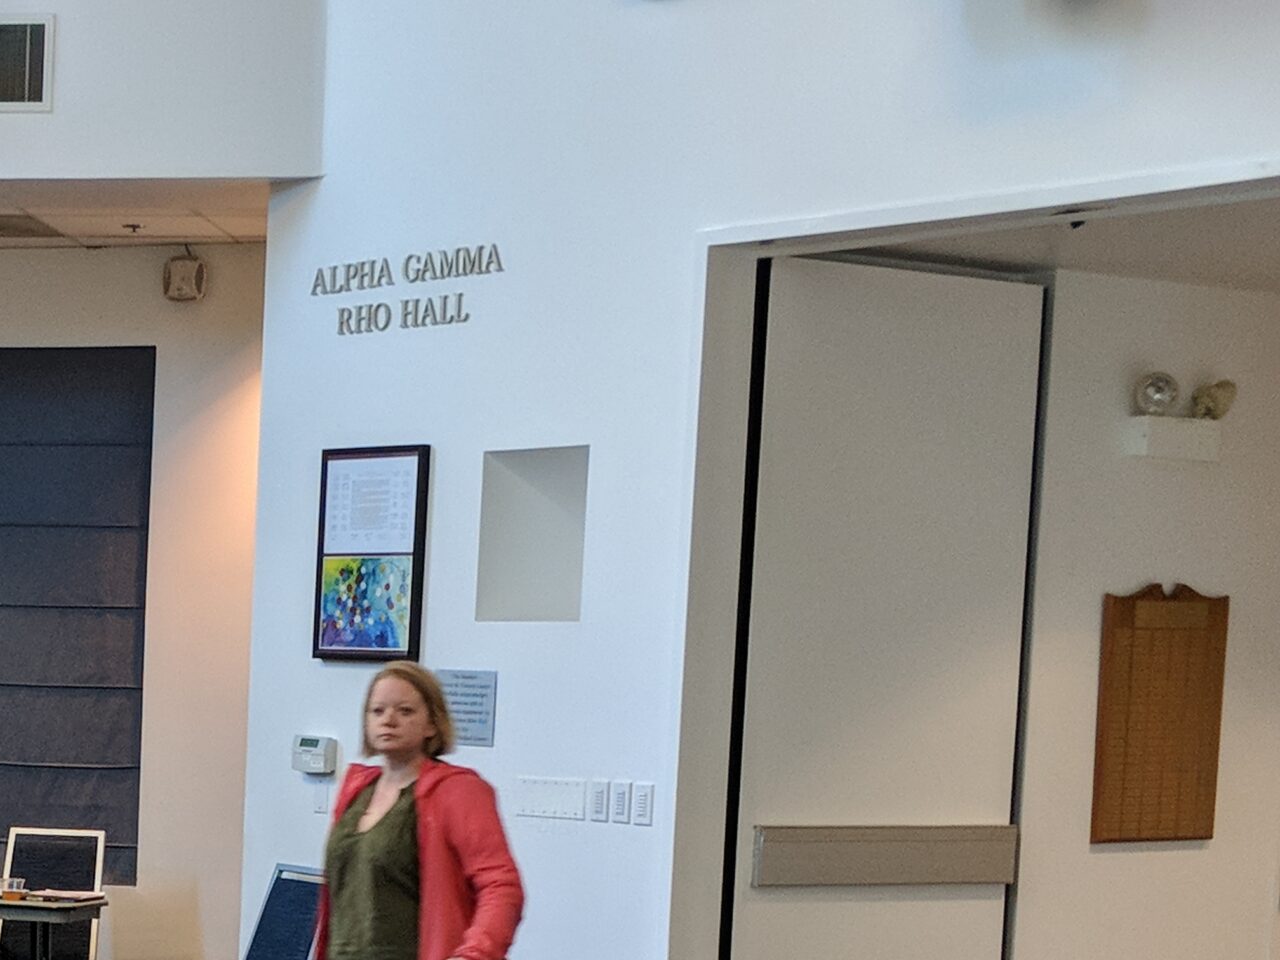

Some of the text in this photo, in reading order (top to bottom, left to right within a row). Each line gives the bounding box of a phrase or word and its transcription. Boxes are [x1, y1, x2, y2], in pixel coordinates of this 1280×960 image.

[310, 243, 505, 296] ALPHA GAMMA
[336, 292, 470, 336] RHO HALL
